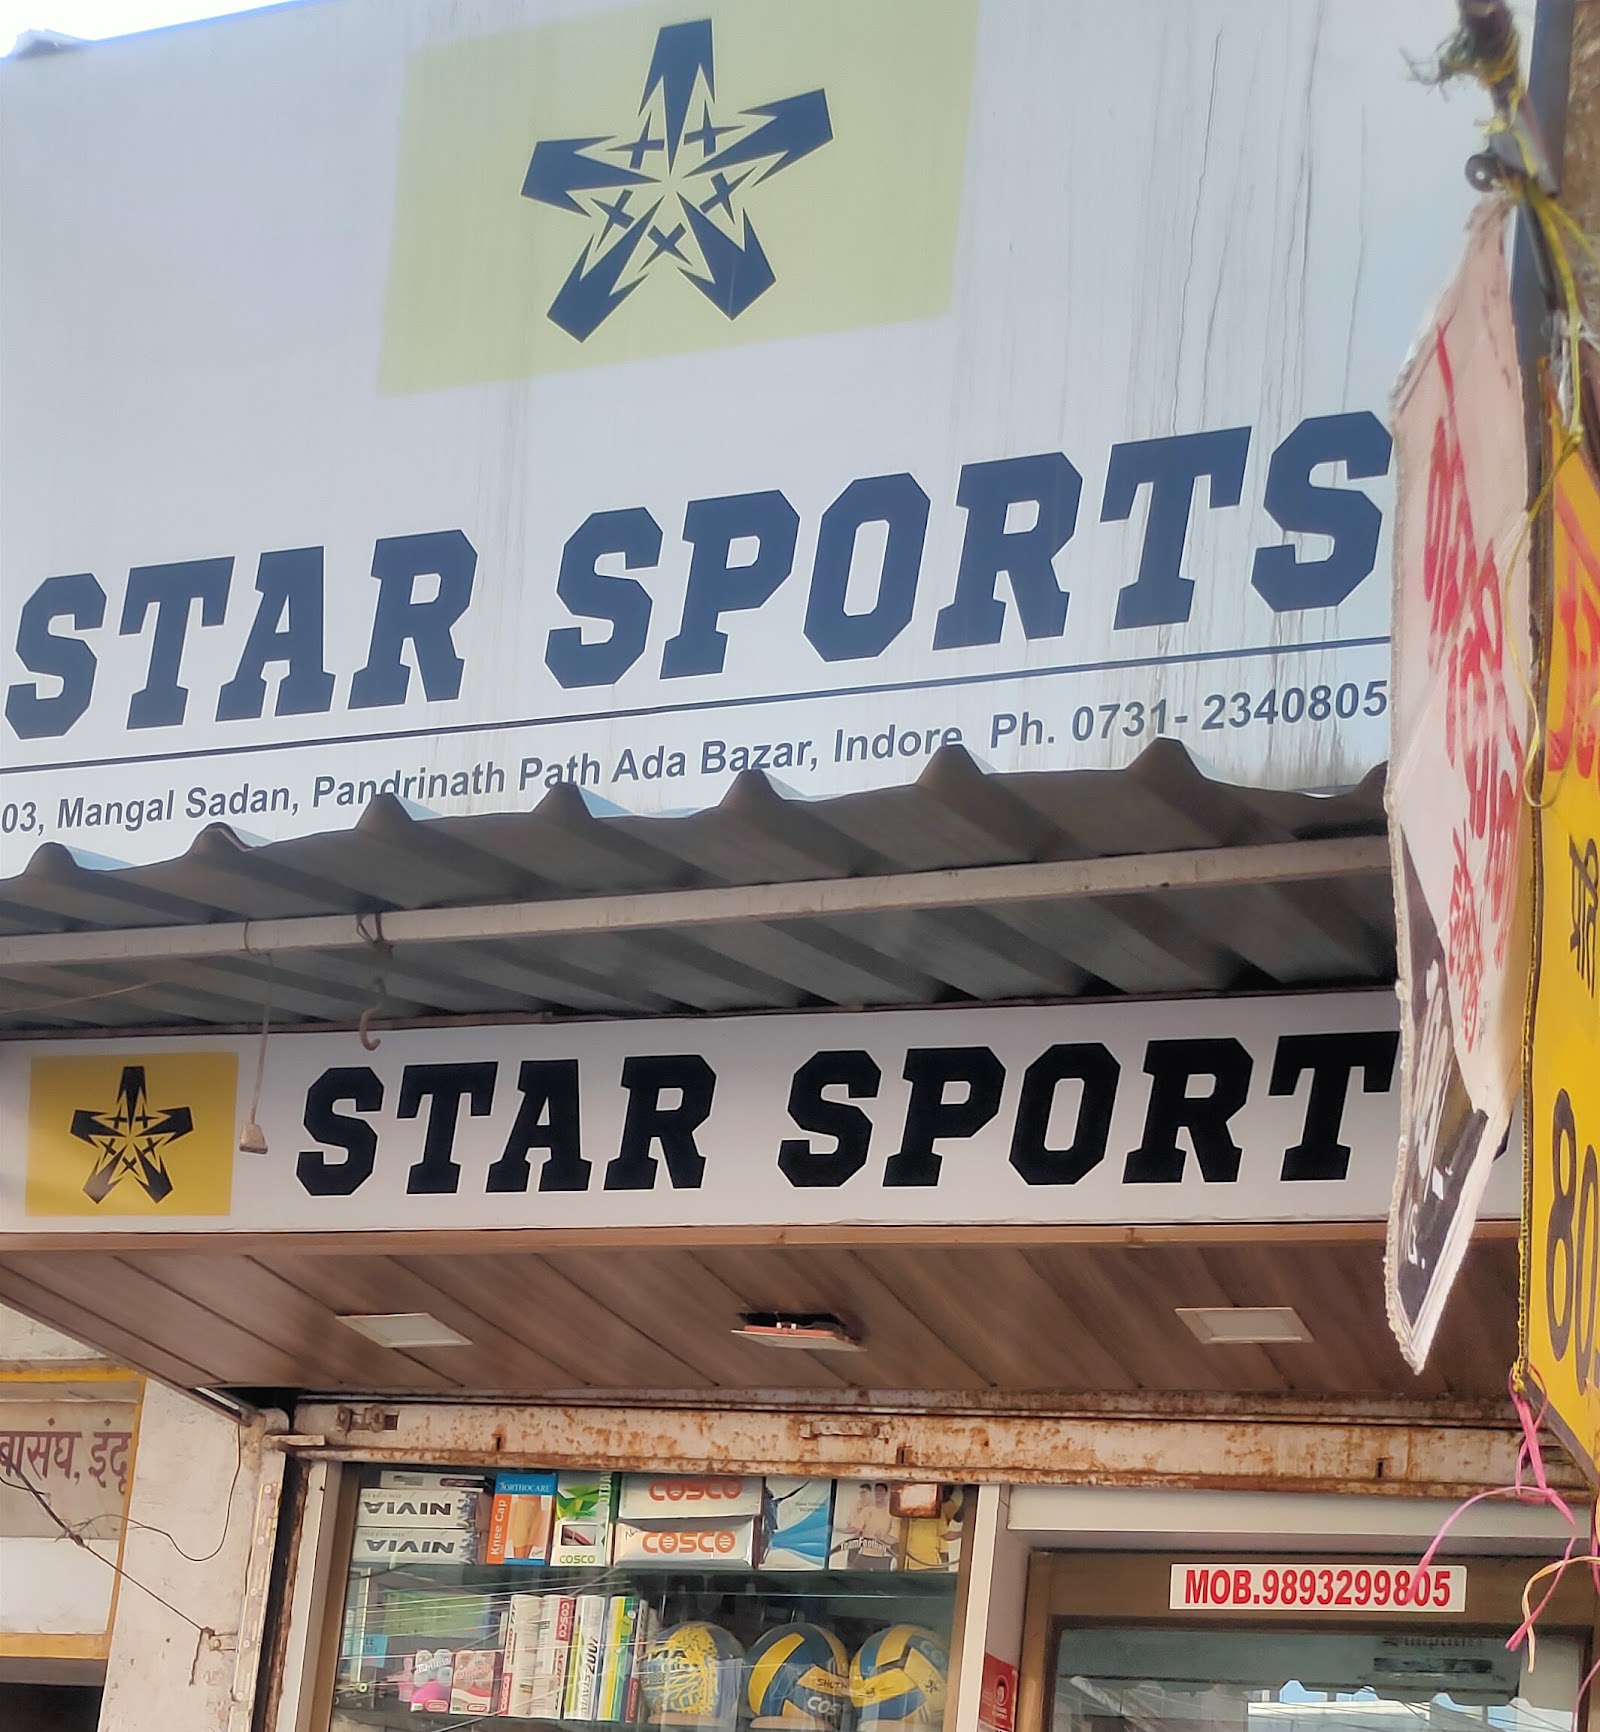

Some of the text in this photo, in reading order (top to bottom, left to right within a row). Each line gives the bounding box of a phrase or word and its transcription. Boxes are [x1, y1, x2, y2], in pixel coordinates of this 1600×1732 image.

[4, 529, 479, 740] STAR
[544, 410, 1393, 689] SPORTS
[56, 788, 174, 840] Mangal
[186, 781, 300, 820] Sadan,
[312, 762, 505, 809] Pandrinath
[519, 752, 600, 790] Path
[611, 744, 686, 783] Ada
[701, 737, 818, 776] Bazar,
[833, 722, 962, 764] Indore
[990, 711, 1056, 749] Ph.
[1201, 680, 1389, 732] 2340805
[296, 1055, 717, 1197] STAR
[776, 1030, 1401, 1188] SPORT
[649, 1478, 743, 1501] COSCO
[362, 1501, 452, 1516] NIVIA
[365, 1538, 455, 1554] NIVIA
[489, 1499, 507, 1557] Knee Cap
[642, 1530, 736, 1554] COSCO
[559, 1554, 596, 1565] COSCO
[1185, 1568, 1452, 1608] MOB.9893299805
[559, 1602, 570, 1638] COSCO
[501, 1675, 510, 1711] COSCO
[806, 1695, 843, 1715] COS
